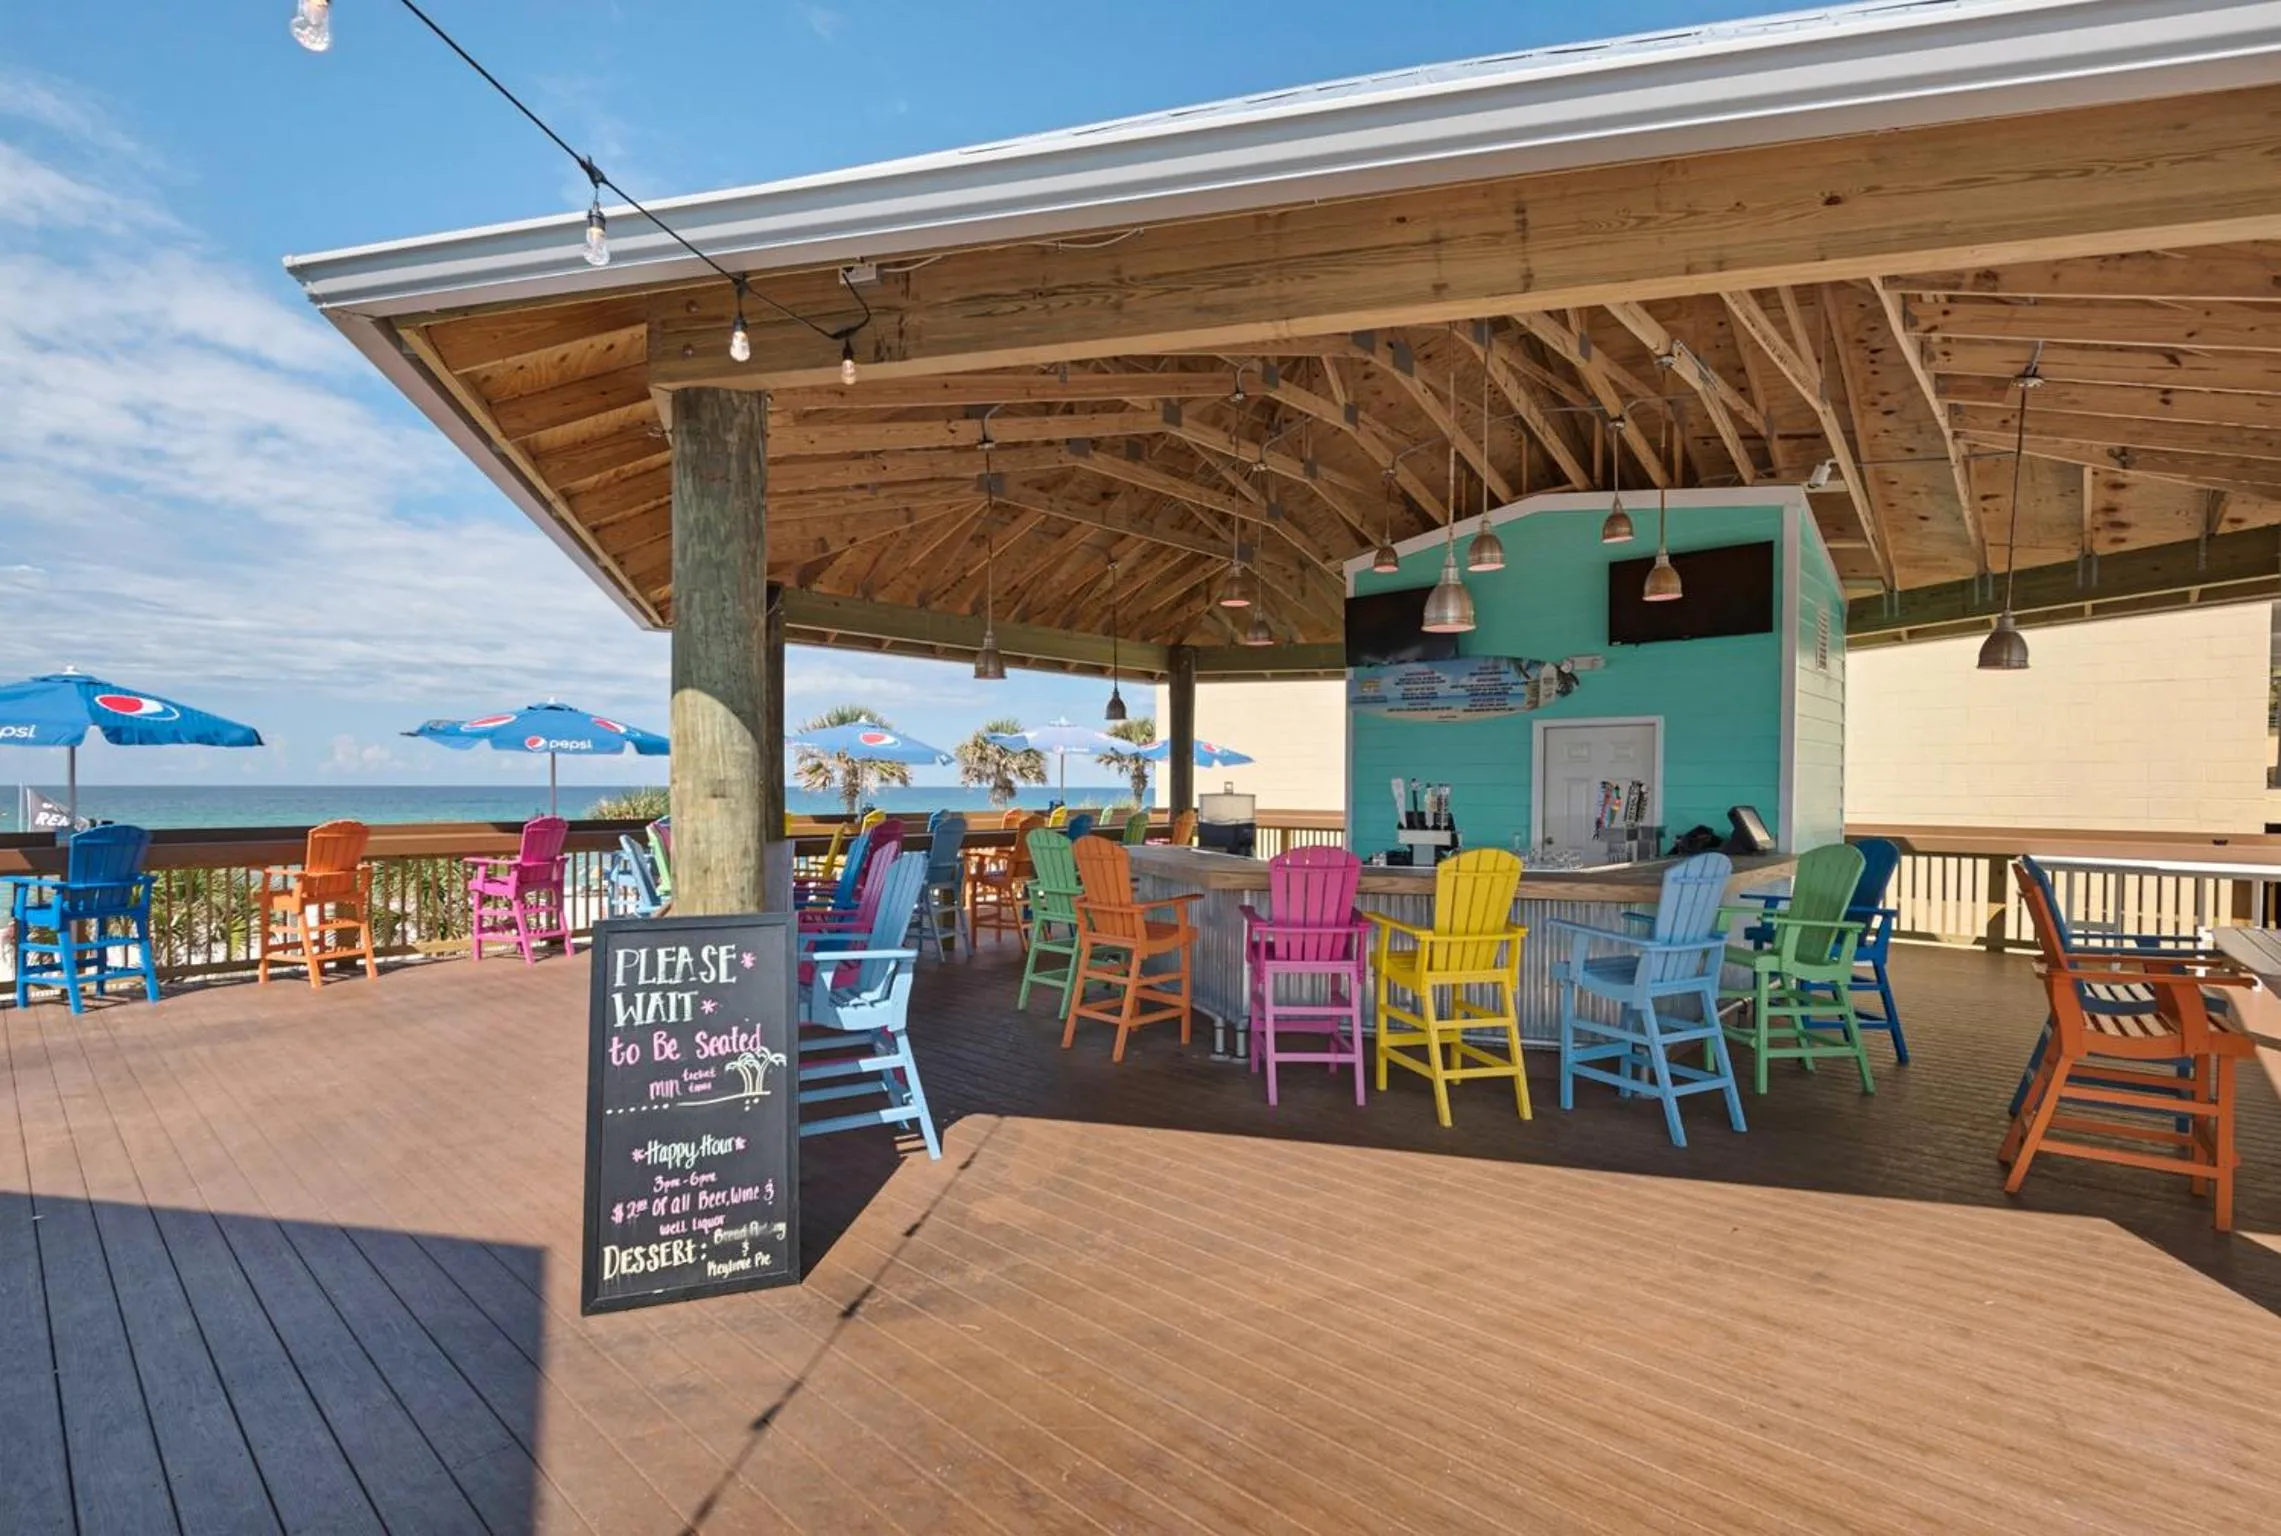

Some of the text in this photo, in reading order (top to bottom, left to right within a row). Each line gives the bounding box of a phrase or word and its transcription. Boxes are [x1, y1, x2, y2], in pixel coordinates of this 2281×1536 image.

[549, 738, 592, 751] pepsi
[613, 944, 737, 987] PLEASE
[612, 991, 699, 1027] WAIT
[609, 1023, 761, 1066] to Be Seated
[645, 1134, 734, 1169] Happy Hour
[671, 1193, 690, 1214] all
[755, 1251, 772, 1268] Pie
